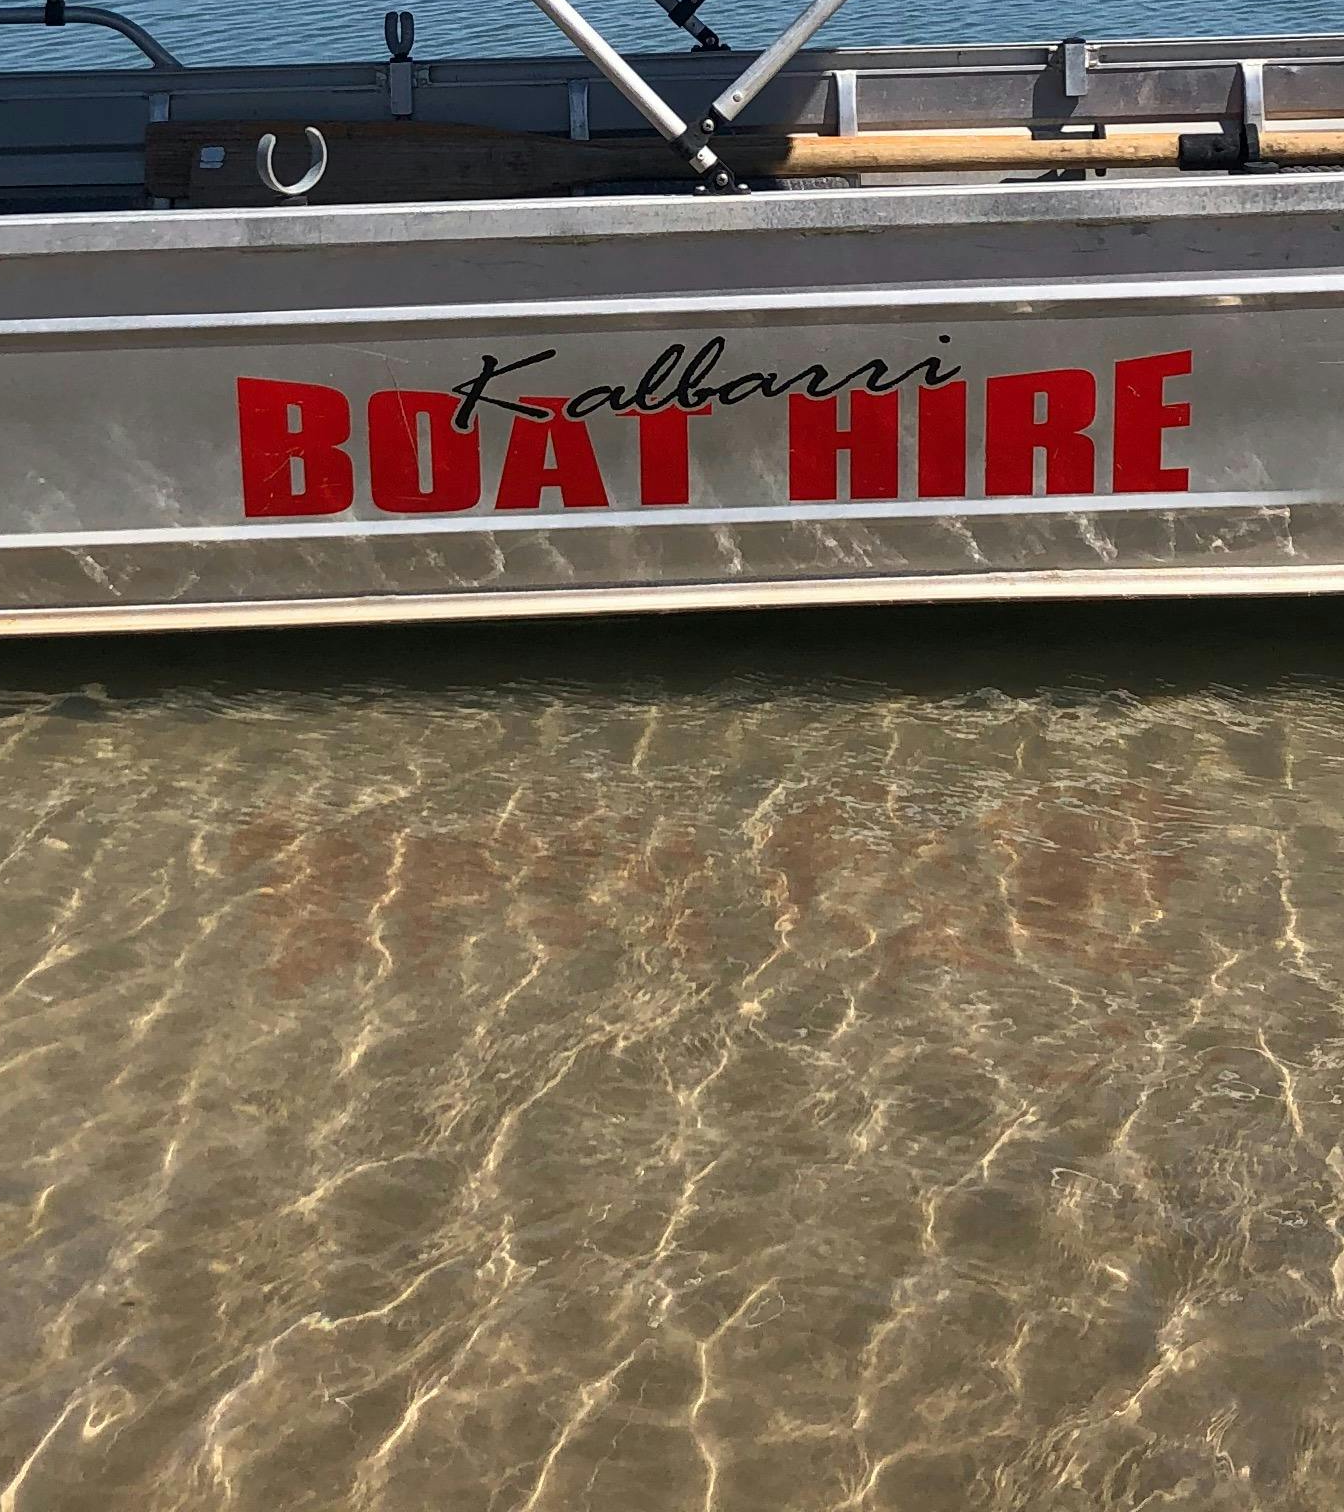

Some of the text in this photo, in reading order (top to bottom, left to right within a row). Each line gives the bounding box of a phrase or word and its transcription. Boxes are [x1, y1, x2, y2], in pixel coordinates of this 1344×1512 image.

[237, 350, 1193, 517] BOAT HIRE
[452, 335, 963, 429] Kalbarri
